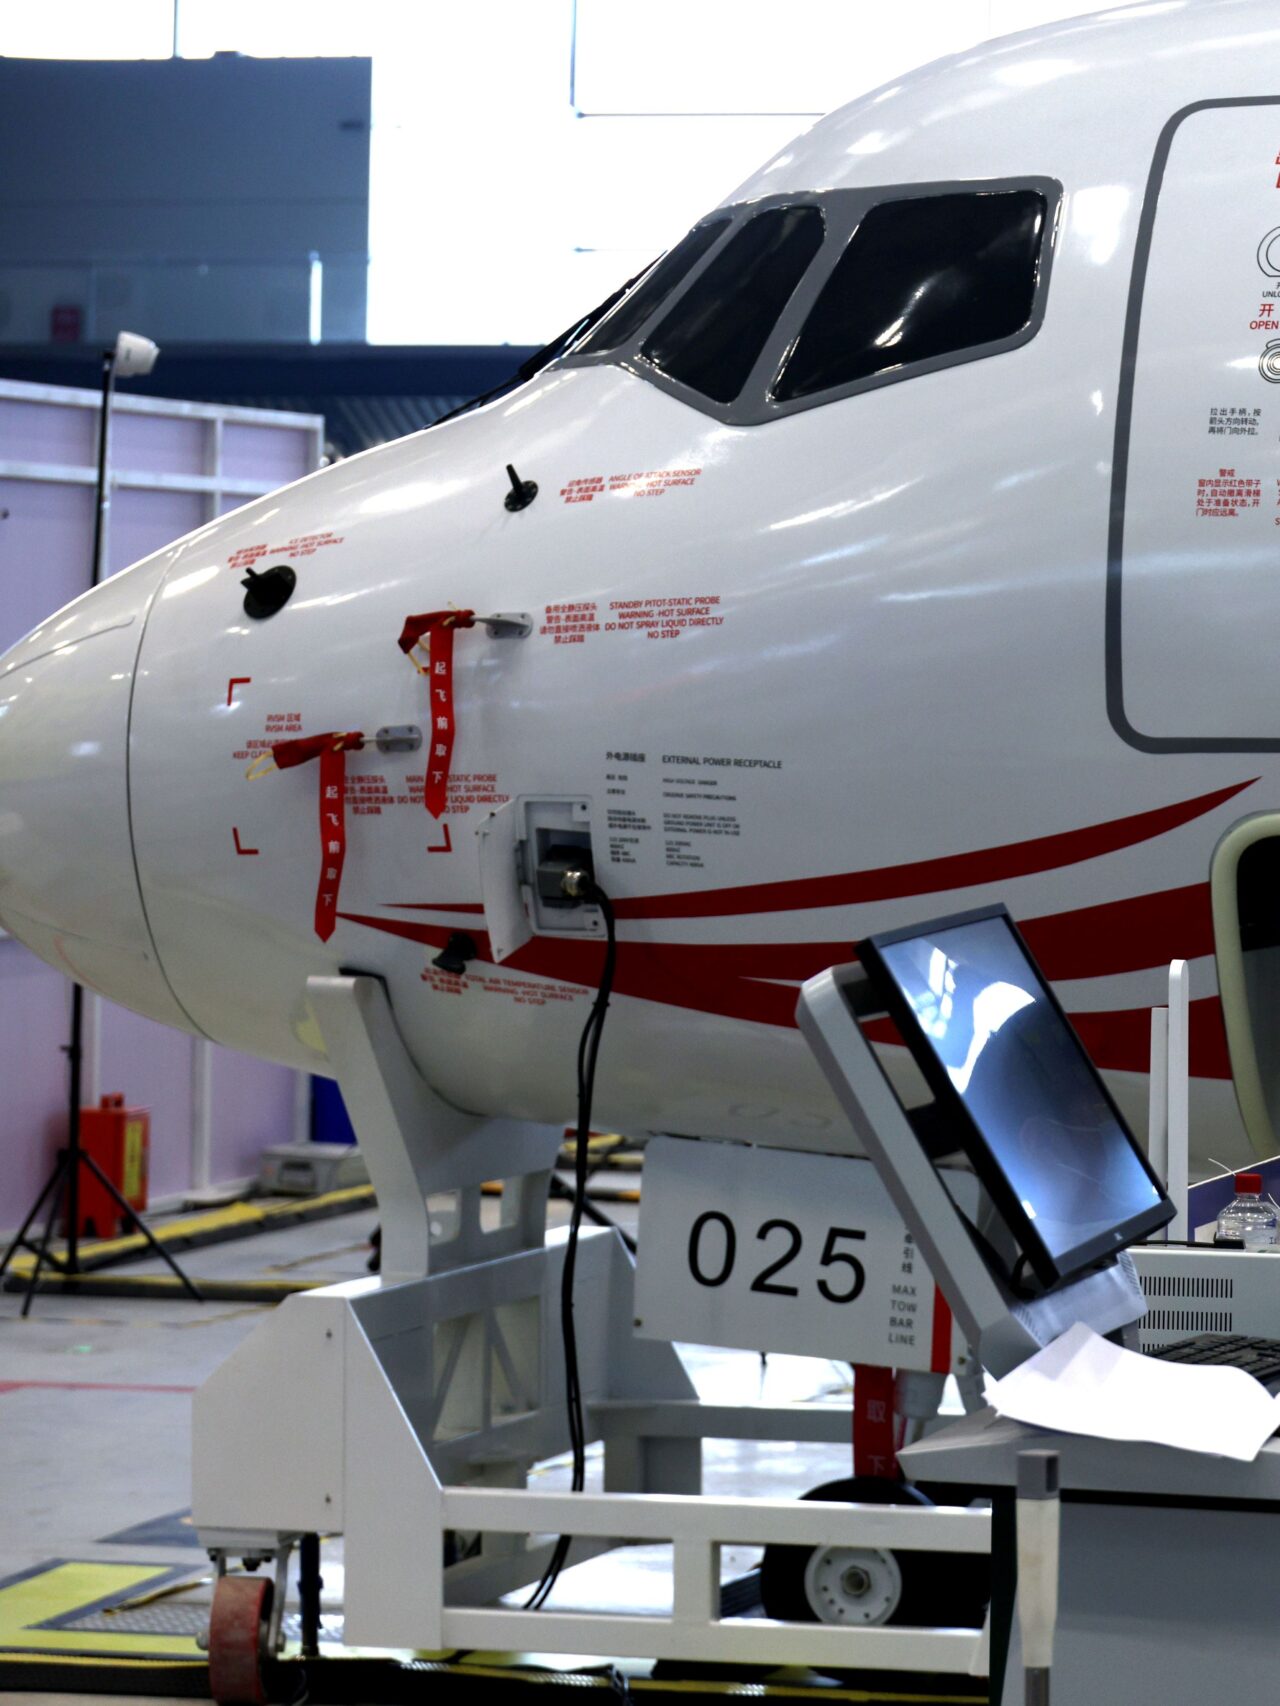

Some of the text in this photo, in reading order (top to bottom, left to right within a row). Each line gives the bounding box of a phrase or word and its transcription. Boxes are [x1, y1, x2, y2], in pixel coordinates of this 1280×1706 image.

[1259, 304, 1274, 317] 开
[1250, 321, 1279, 330] OPEN
[608, 474, 631, 482] ANGLE
[672, 468, 702, 477] SENSOR
[664, 478, 695, 486] SURFACE
[634, 488, 665, 497] NO STEP
[610, 596, 721, 610] STANDBY PITOT-STATIC PROBE
[618, 610, 654, 620] WARNING
[676, 607, 710, 617] SURFACE
[605, 617, 724, 631] DO NOT SPRAY LIQUID DIRECTLY
[647, 629, 680, 639] NO STEP
[662, 755, 782, 769] EXTERNAL POWER RECEPTACLE
[473, 774, 497, 782] PROBE
[463, 784, 495, 793] SURFACE
[398, 795, 510, 804] DO NOT LIQUID DIRECTLY
[452, 805, 470, 813] STEP
[688, 1210, 867, 1304] 025
[892, 1284, 917, 1296] MAX
[890, 1300, 917, 1313] TOW
[889, 1316, 913, 1329] BAR
[888, 1332, 916, 1347] LINE
